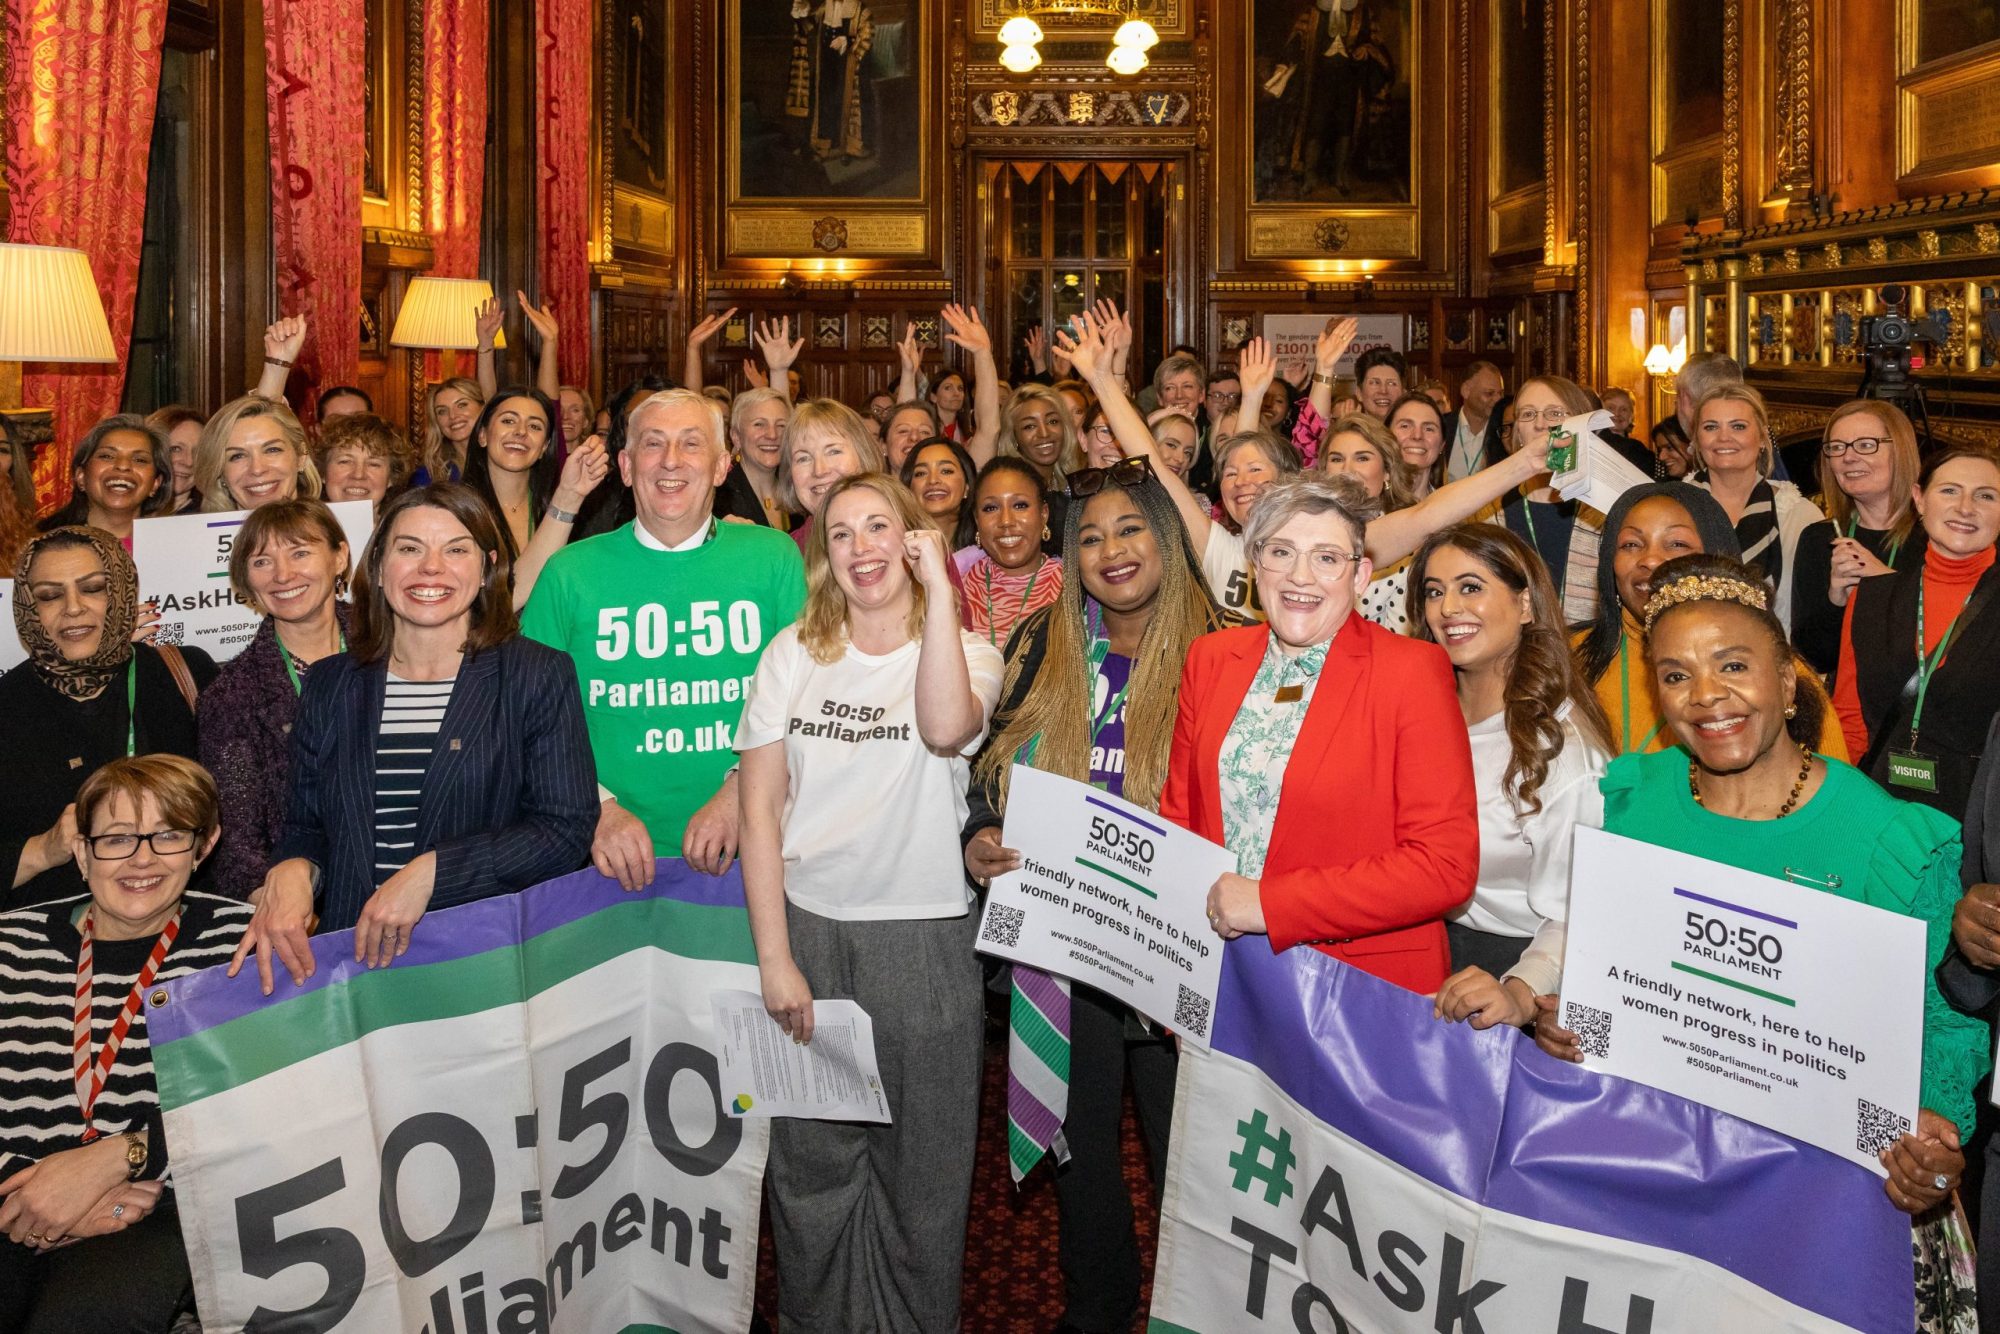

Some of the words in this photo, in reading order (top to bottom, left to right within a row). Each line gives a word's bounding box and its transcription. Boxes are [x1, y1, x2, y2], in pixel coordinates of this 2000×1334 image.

[1276, 343, 1308, 354] £100
[595, 600, 762, 661] 50:50
[788, 717, 911, 744] Parliament
[820, 699, 886, 723] 50:50
[636, 720, 733, 754] .co.uk
[1894, 764, 1931, 780] VISITOR
[1086, 840, 1152, 876] PARLIAMENT
[1088, 816, 1154, 863] 50:50
[1020, 882, 1069, 908] women
[1072, 902, 1130, 936] progress
[1134, 926, 1146, 944] in
[1148, 934, 1194, 972] politics
[1023, 858, 1076, 889] friendly
[1078, 879, 1132, 916] network,
[1136, 905, 1163, 931] here
[1166, 922, 1178, 939] to
[1182, 931, 1210, 959] help
[1050, 929, 1156, 984] www.5050Parliament.co.uk
[1684, 911, 1783, 964] 50:50
[1684, 941, 1782, 981] PARLIAMENT
[1069, 949, 1134, 988] #5050Parliament
[1607, 966, 1619, 980] A
[1623, 969, 1682, 1001] friendly
[1687, 992, 1757, 1026] network,
[1762, 1014, 1800, 1039] here
[1804, 1030, 1822, 1047] to
[1828, 1036, 1866, 1064] help
[1622, 994, 1678, 1022] women
[1684, 1013, 1757, 1047] progress
[1762, 1038, 1778, 1055] in
[1782, 1048, 1847, 1080] politics
[1662, 1034, 1799, 1088] www.5050Parliament.co.uk
[1686, 1056, 1772, 1094] #5050Parliament
[234, 1036, 742, 1334] 50:50
